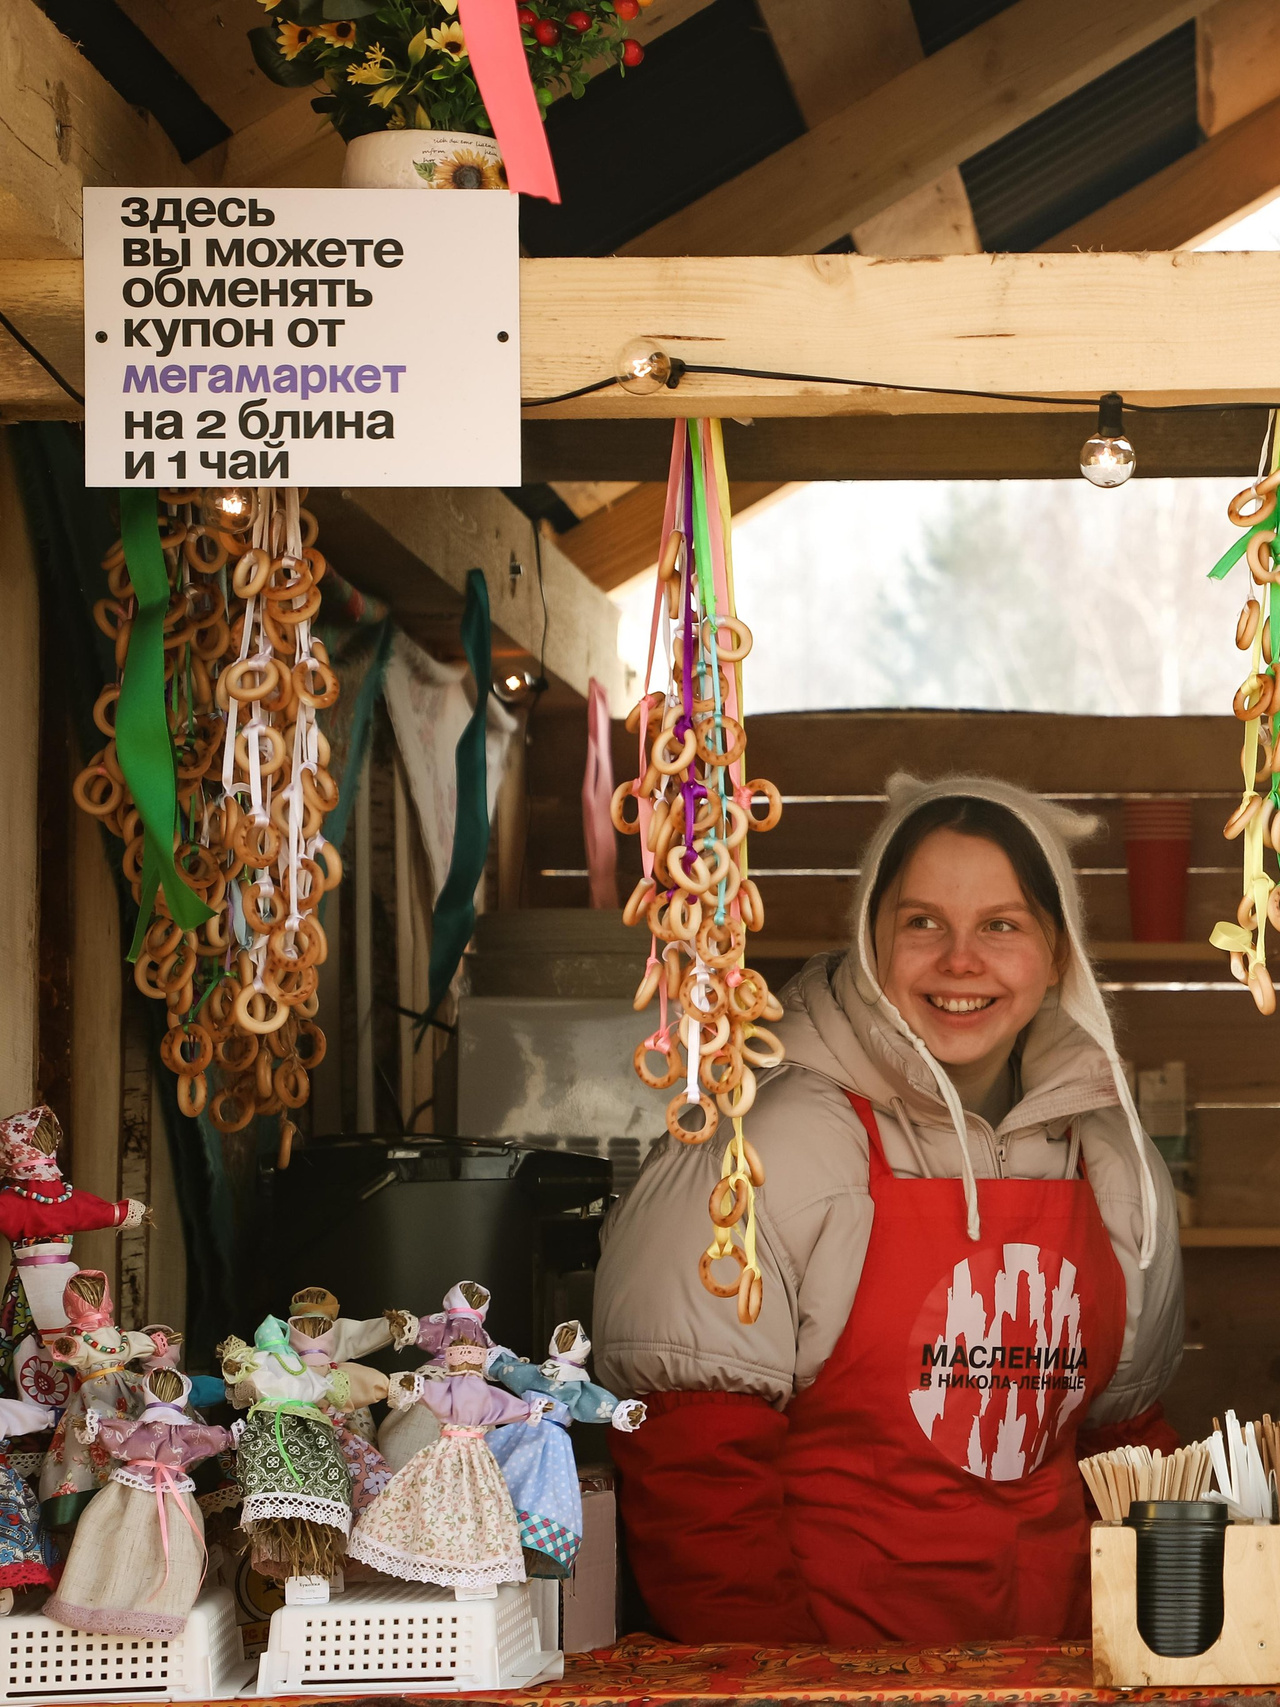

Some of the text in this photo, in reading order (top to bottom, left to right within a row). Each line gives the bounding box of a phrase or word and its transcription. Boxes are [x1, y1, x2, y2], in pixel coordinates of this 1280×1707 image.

[121, 197, 275, 233] здесь
[123, 238, 404, 268] вы можете
[122, 266, 373, 307] обменять
[124, 318, 345, 357] купон от
[122, 364, 406, 400] мегамаркет
[125, 399, 394, 440] на 2 блина
[125, 441, 289, 480] и 1 чай
[921, 1344, 1088, 1373] МАСЛЕНИЦА
[920, 1373, 1084, 1393] В НИКОЛА-ЛЕНИВЦЕ
